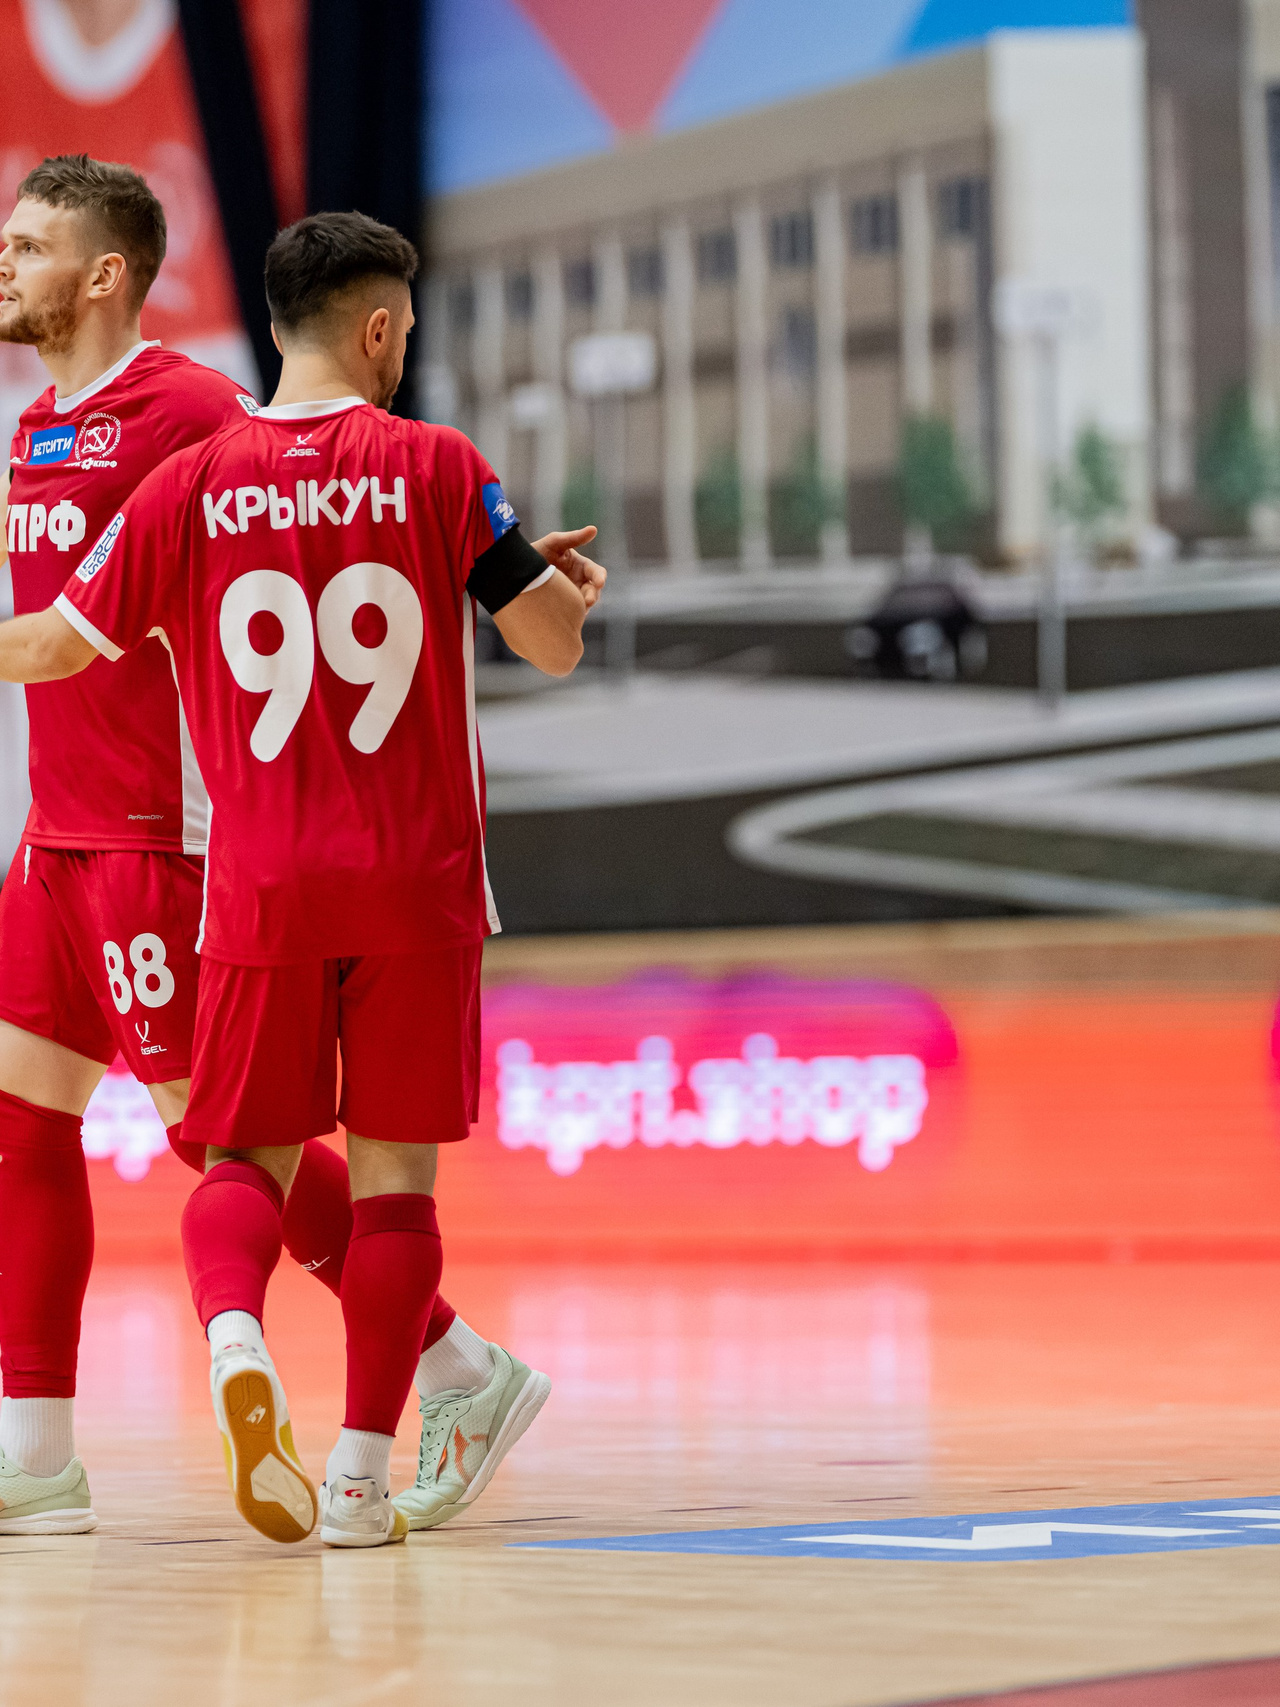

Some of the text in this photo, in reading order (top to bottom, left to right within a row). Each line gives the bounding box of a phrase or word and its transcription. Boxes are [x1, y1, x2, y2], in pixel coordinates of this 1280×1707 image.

[32, 436, 73, 457] БЕТСИТИ
[93, 460, 118, 468] КПРФ
[282, 447, 320, 457] JÖGEL
[8, 499, 86, 552] ПРФ
[202, 476, 407, 538] КРЫКУН
[219, 561, 423, 763] 99
[103, 932, 175, 1015] 88
[497, 1033, 928, 1175] kprf.shop
